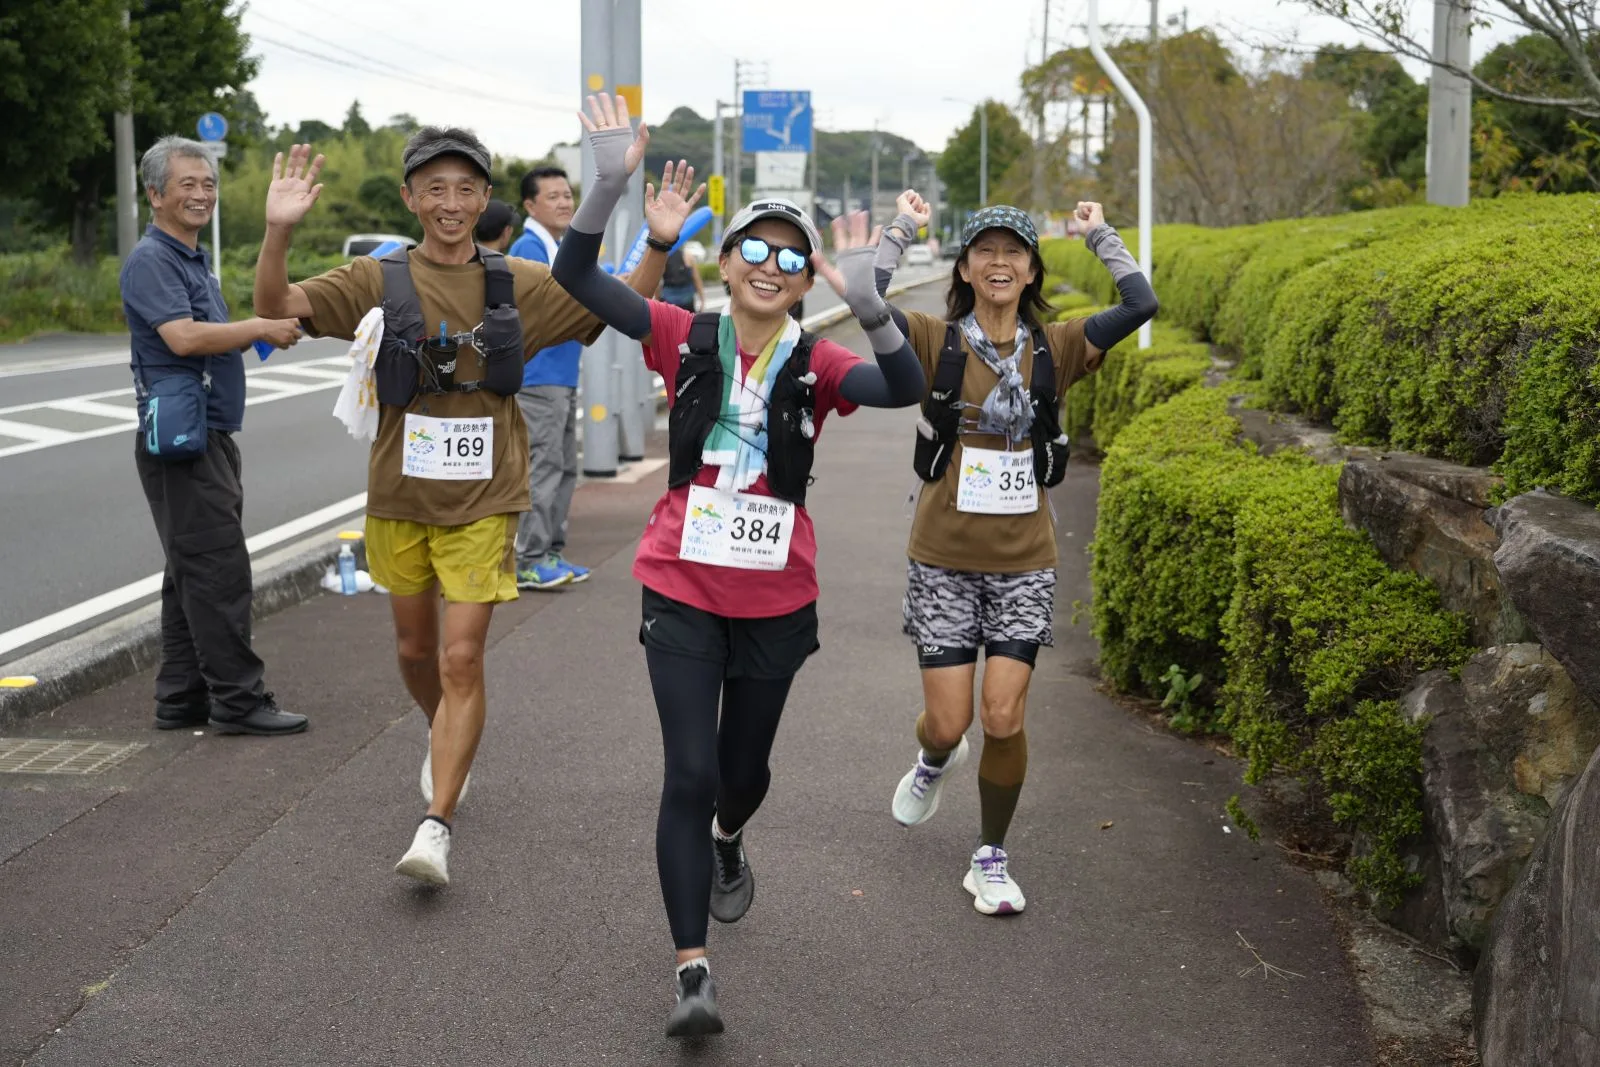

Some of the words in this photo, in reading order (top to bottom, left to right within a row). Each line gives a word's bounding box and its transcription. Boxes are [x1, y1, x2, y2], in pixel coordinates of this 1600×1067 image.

[453, 422, 488, 433] 高砂熱学
[443, 437, 484, 457] 169
[1044, 442, 1054, 484] NATHAN
[999, 469, 1034, 491] 354
[747, 502, 788, 516] 高砂熱学
[730, 517, 781, 545] 384
